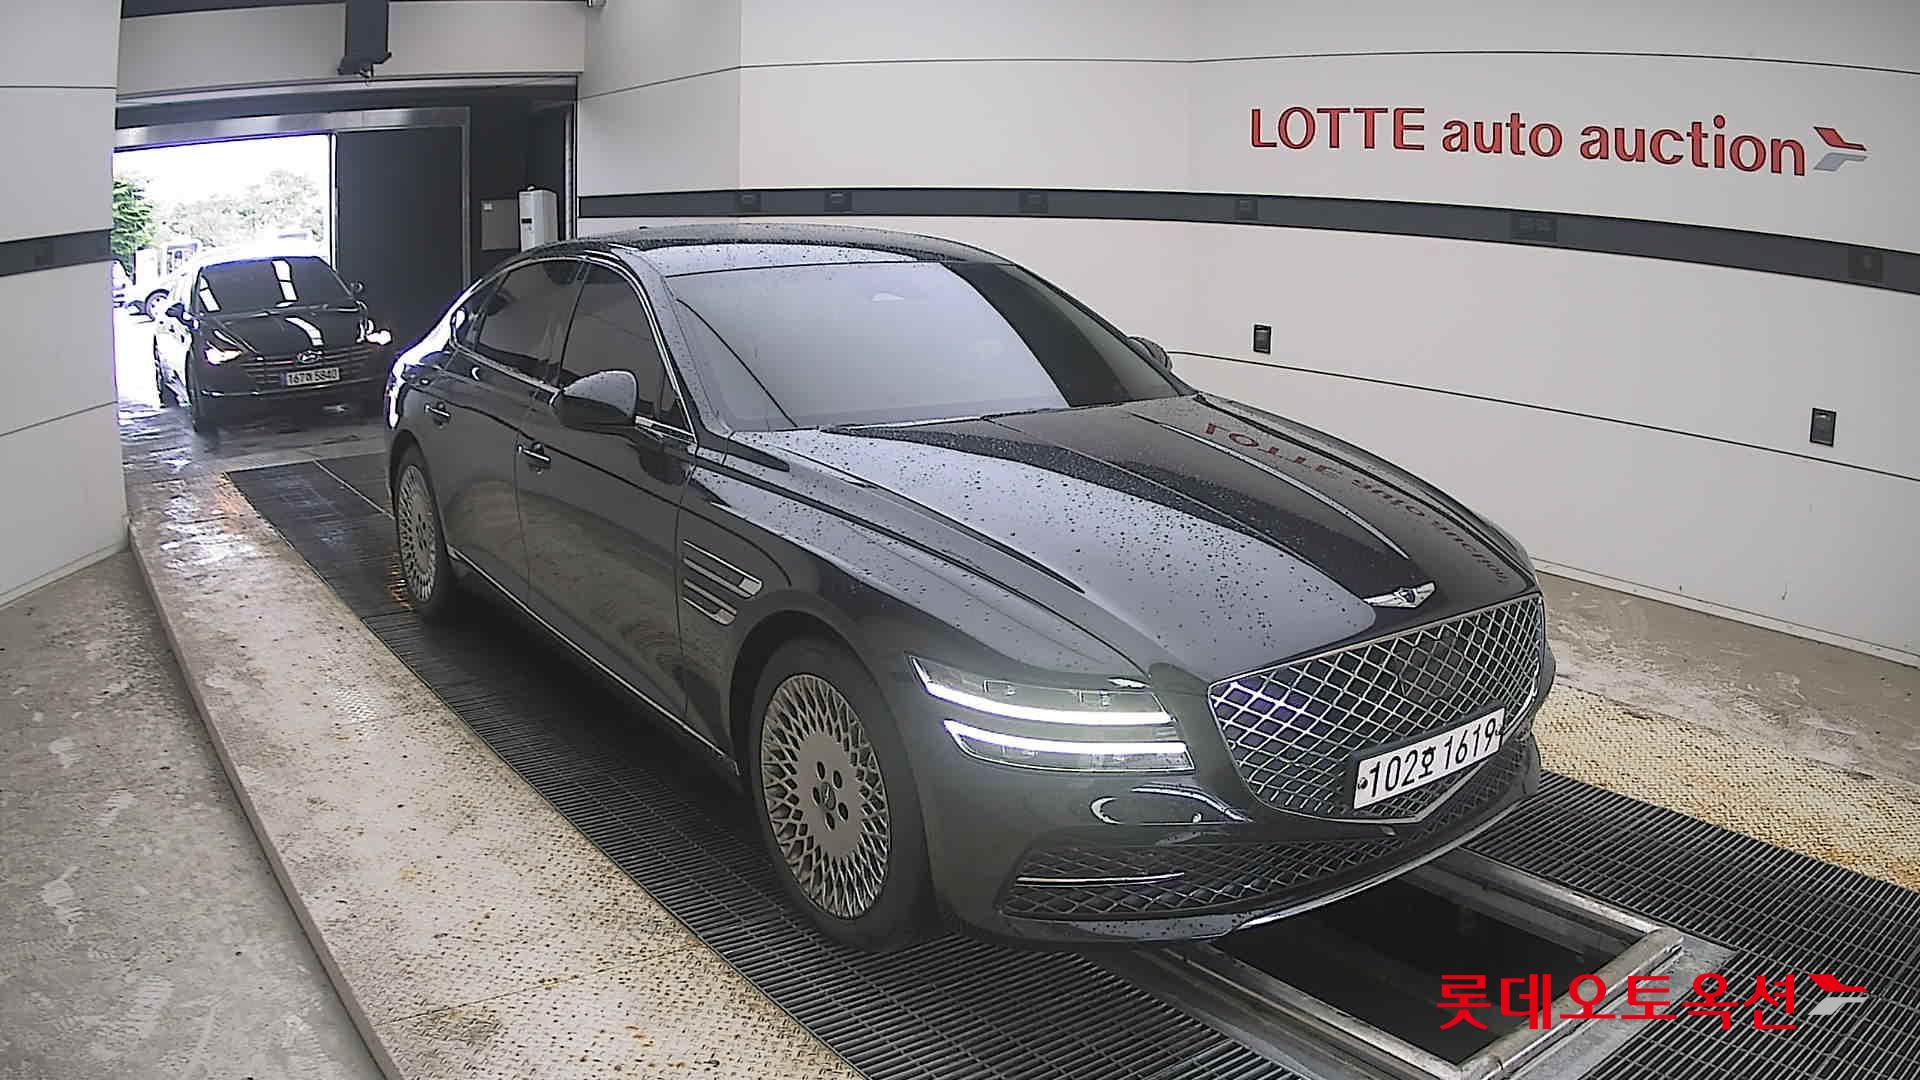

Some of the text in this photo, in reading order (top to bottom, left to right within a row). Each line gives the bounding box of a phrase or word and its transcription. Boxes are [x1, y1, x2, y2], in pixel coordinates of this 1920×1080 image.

[1251, 107, 1806, 176] LOTTE auto auction
[1369, 717, 1497, 798] 102호 1619
